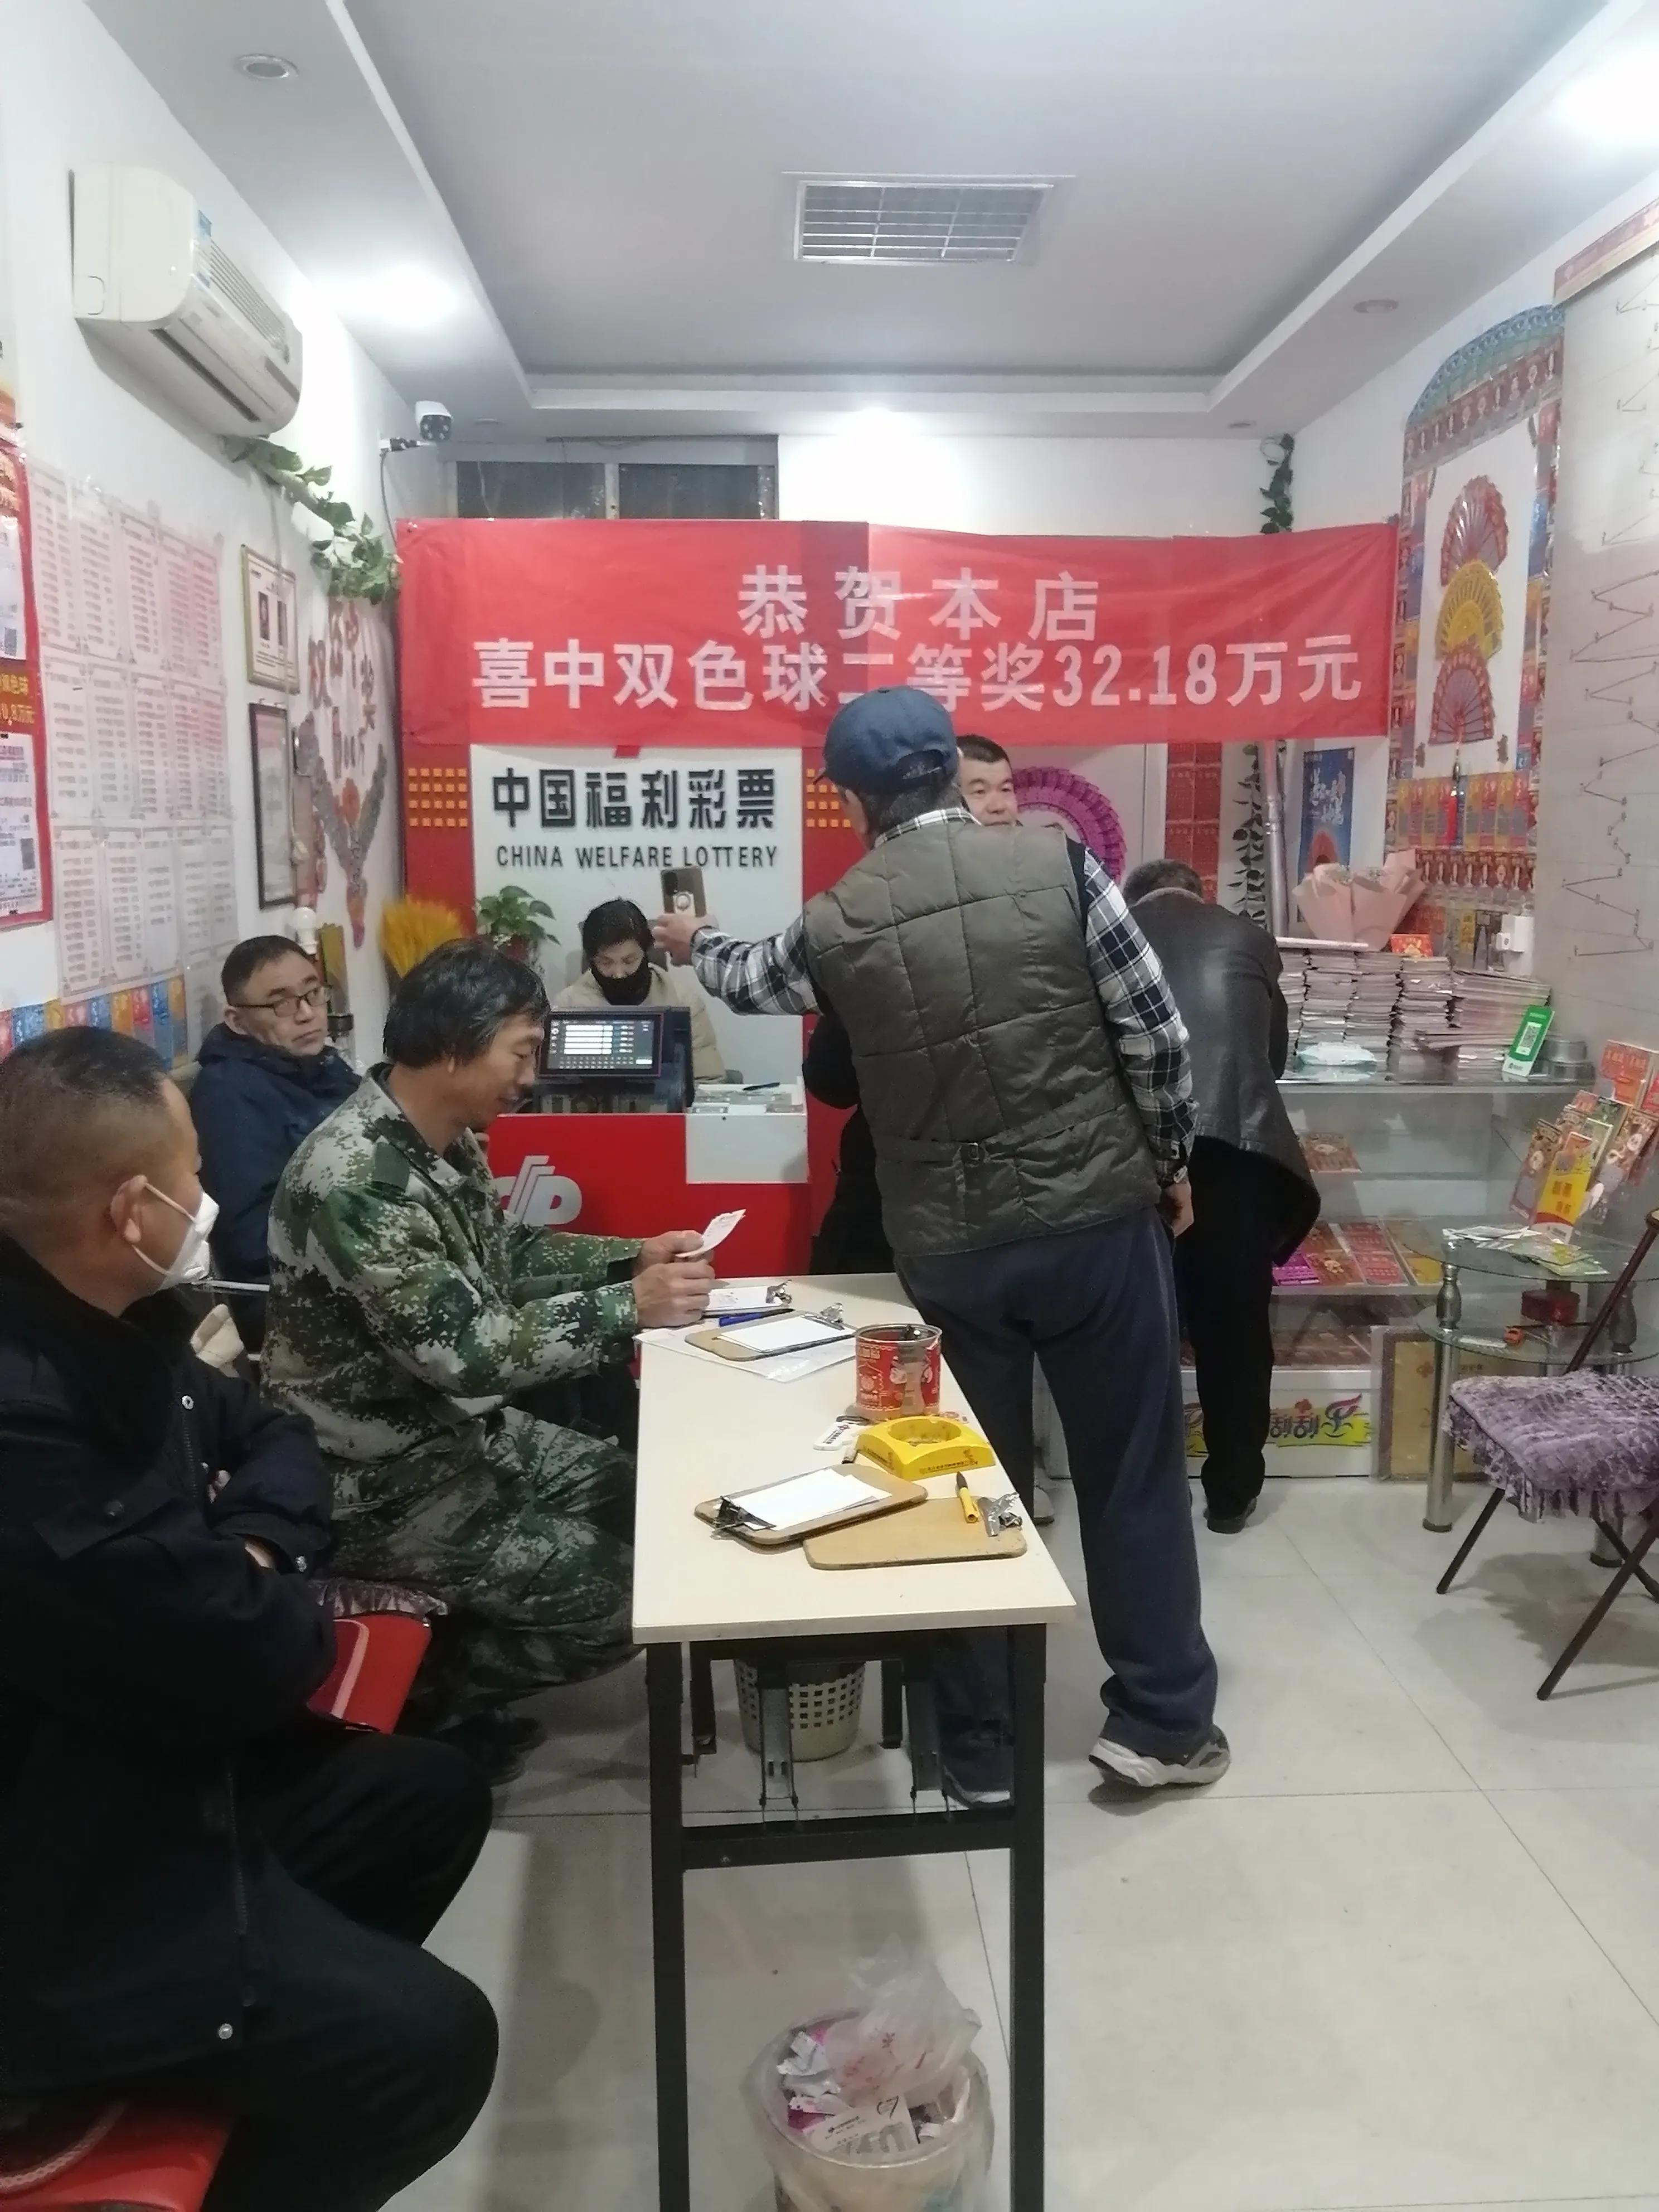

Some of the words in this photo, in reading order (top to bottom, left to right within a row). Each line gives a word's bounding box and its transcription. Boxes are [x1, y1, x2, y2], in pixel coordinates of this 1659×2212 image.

[738, 565, 1099, 642] 恭贺本店
[492, 768, 776, 830] 中国福利彩票
[496, 845, 563, 868] CHINA
[575, 845, 673, 868] WELFARE
[683, 845, 778, 867] LOTTERY
